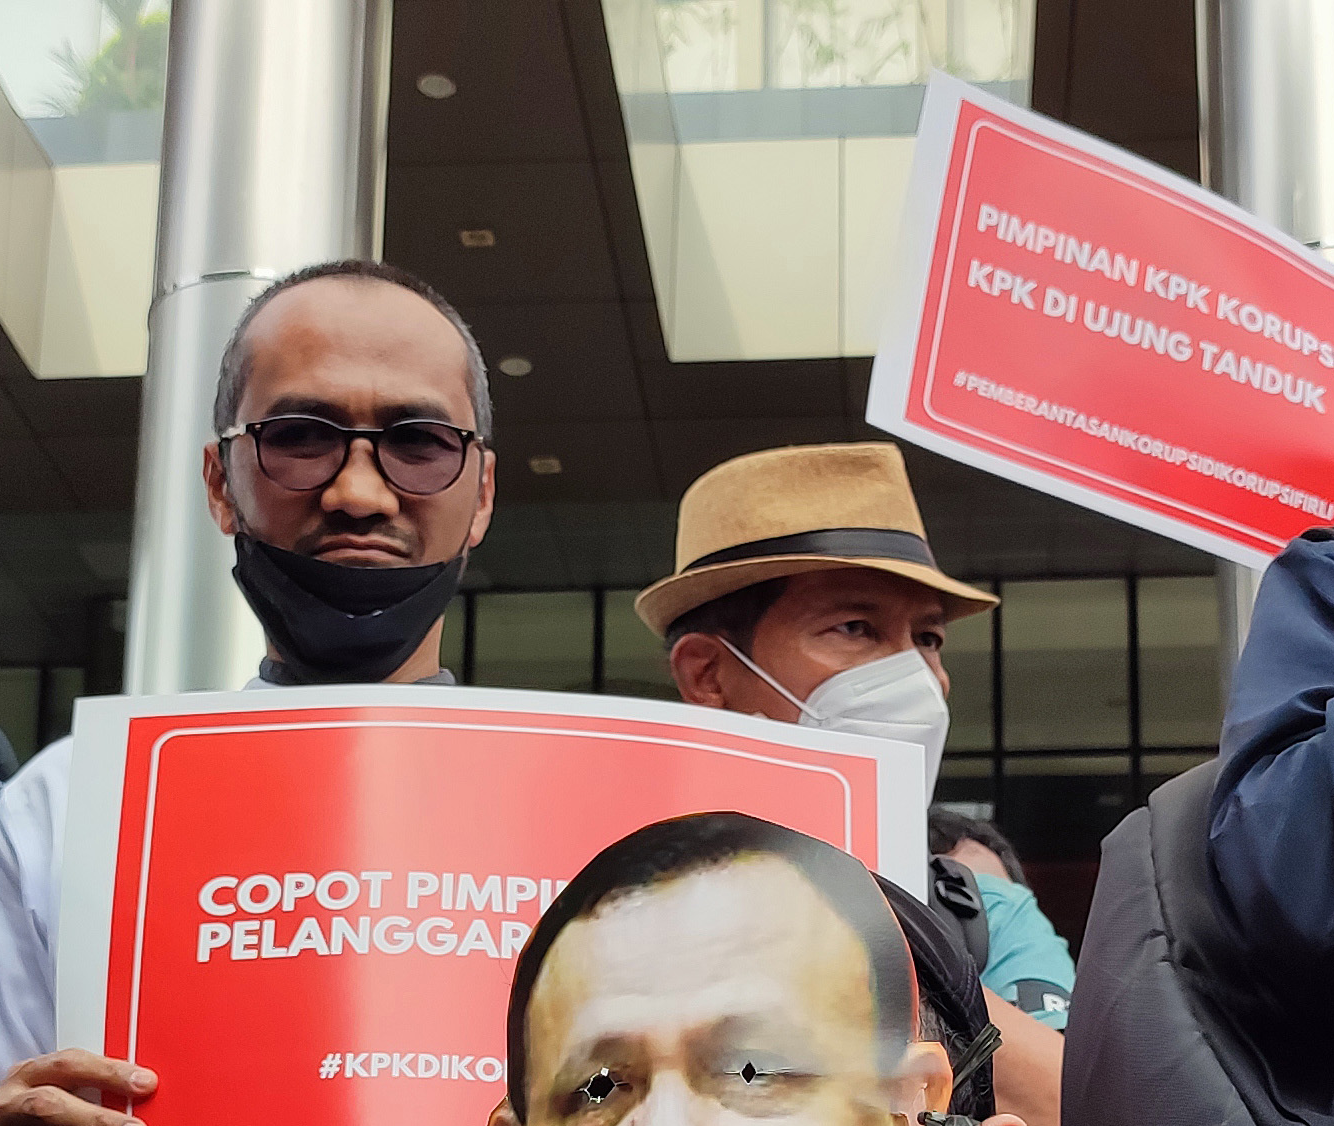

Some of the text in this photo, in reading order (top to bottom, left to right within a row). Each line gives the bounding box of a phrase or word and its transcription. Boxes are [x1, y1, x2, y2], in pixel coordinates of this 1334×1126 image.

[976, 203, 1140, 287] PIMPINAN
[1143, 264, 1211, 314] KPK
[967, 258, 1327, 414] KPK DI UJUNG TANDUK
[198, 870, 569, 916] COPOT PIMPI
[196, 915, 532, 963] PELANGGAR
[318, 1052, 508, 1084] #KPKDIKO
